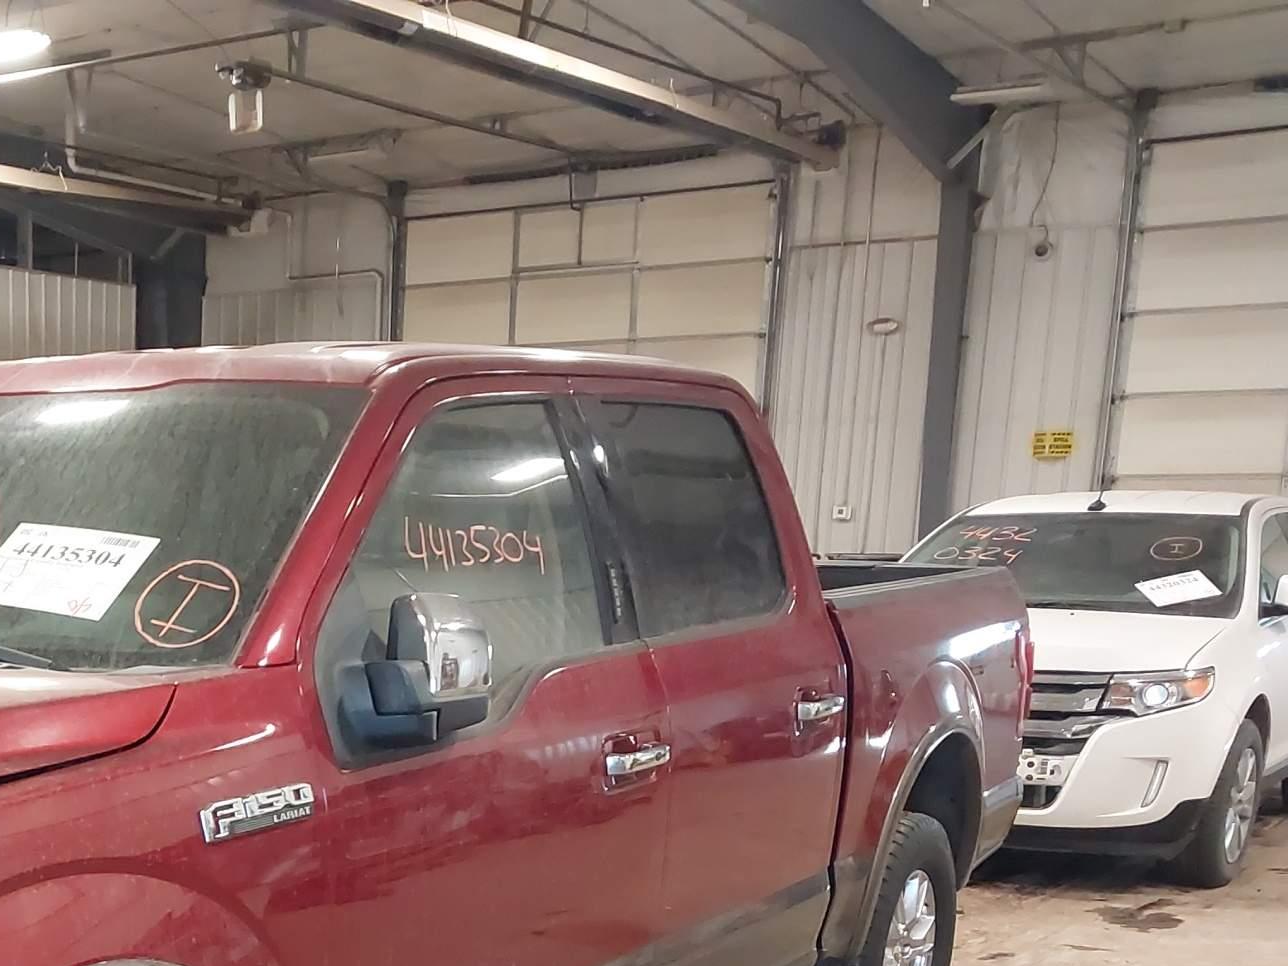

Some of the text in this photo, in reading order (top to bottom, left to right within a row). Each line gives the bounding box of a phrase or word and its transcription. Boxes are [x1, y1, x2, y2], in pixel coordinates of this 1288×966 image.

[12, 541, 126, 568] 44135304
[404, 515, 545, 576] 44135304
[933, 546, 1024, 565] 0324
[273, 805, 312, 823] LARIAT
